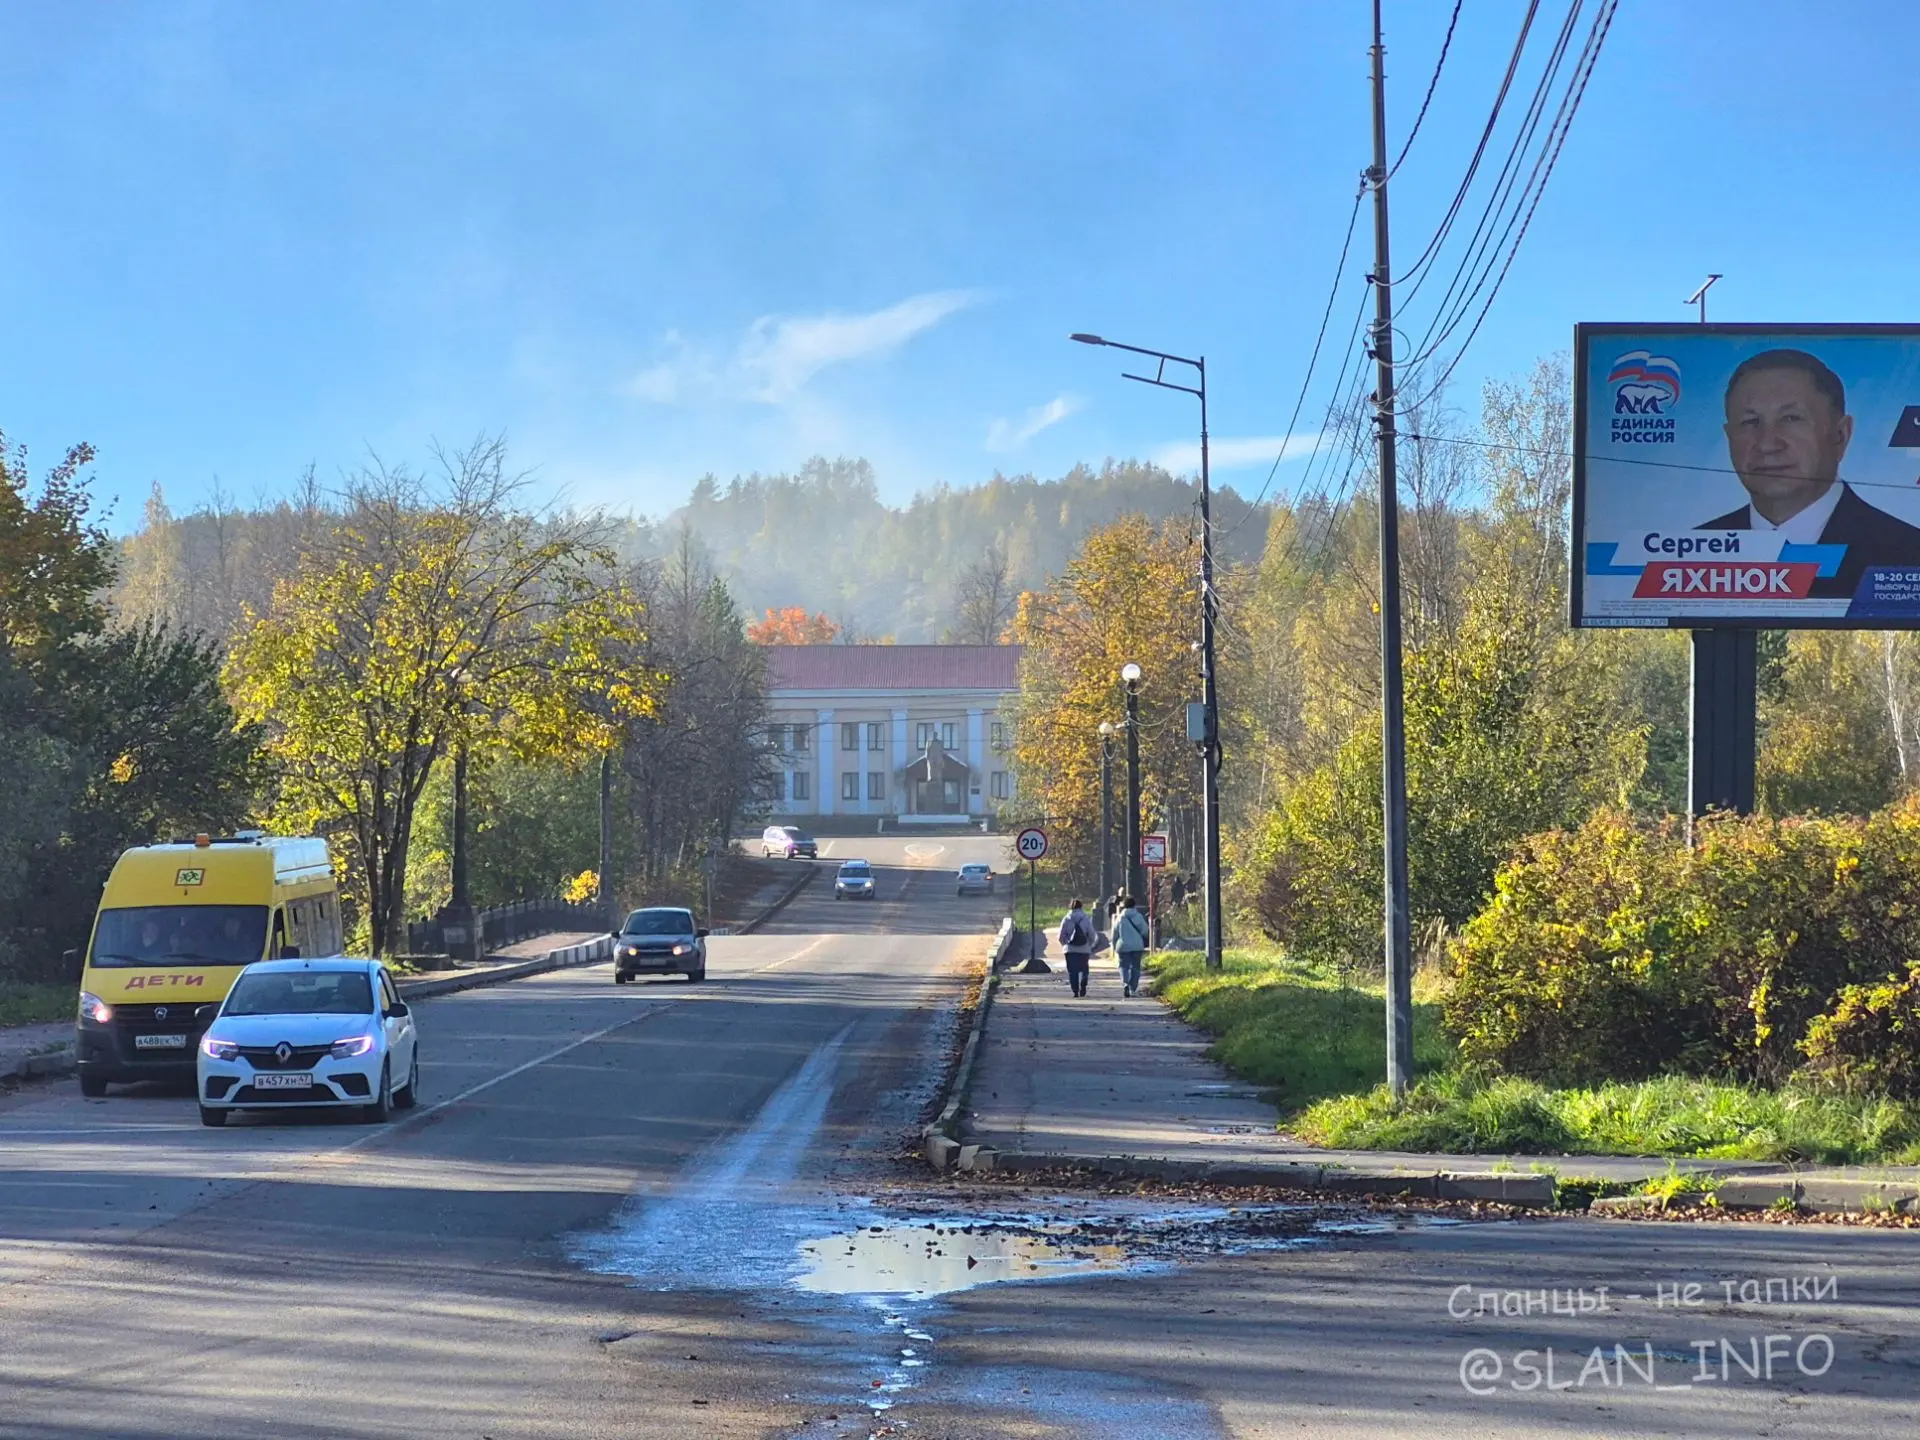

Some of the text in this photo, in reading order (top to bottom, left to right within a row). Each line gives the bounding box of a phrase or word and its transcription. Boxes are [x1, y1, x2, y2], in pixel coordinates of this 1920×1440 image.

[1611, 418, 1675, 430] ЕДИНАЯ
[1611, 431, 1675, 443] РОССИЯ
[1643, 532, 1740, 558] Сергей
[1660, 568, 1792, 593] ЯХНЮК
[1874, 573, 1920, 581] 18-20 СЕ
[124, 975, 204, 990] ДЕТИ
